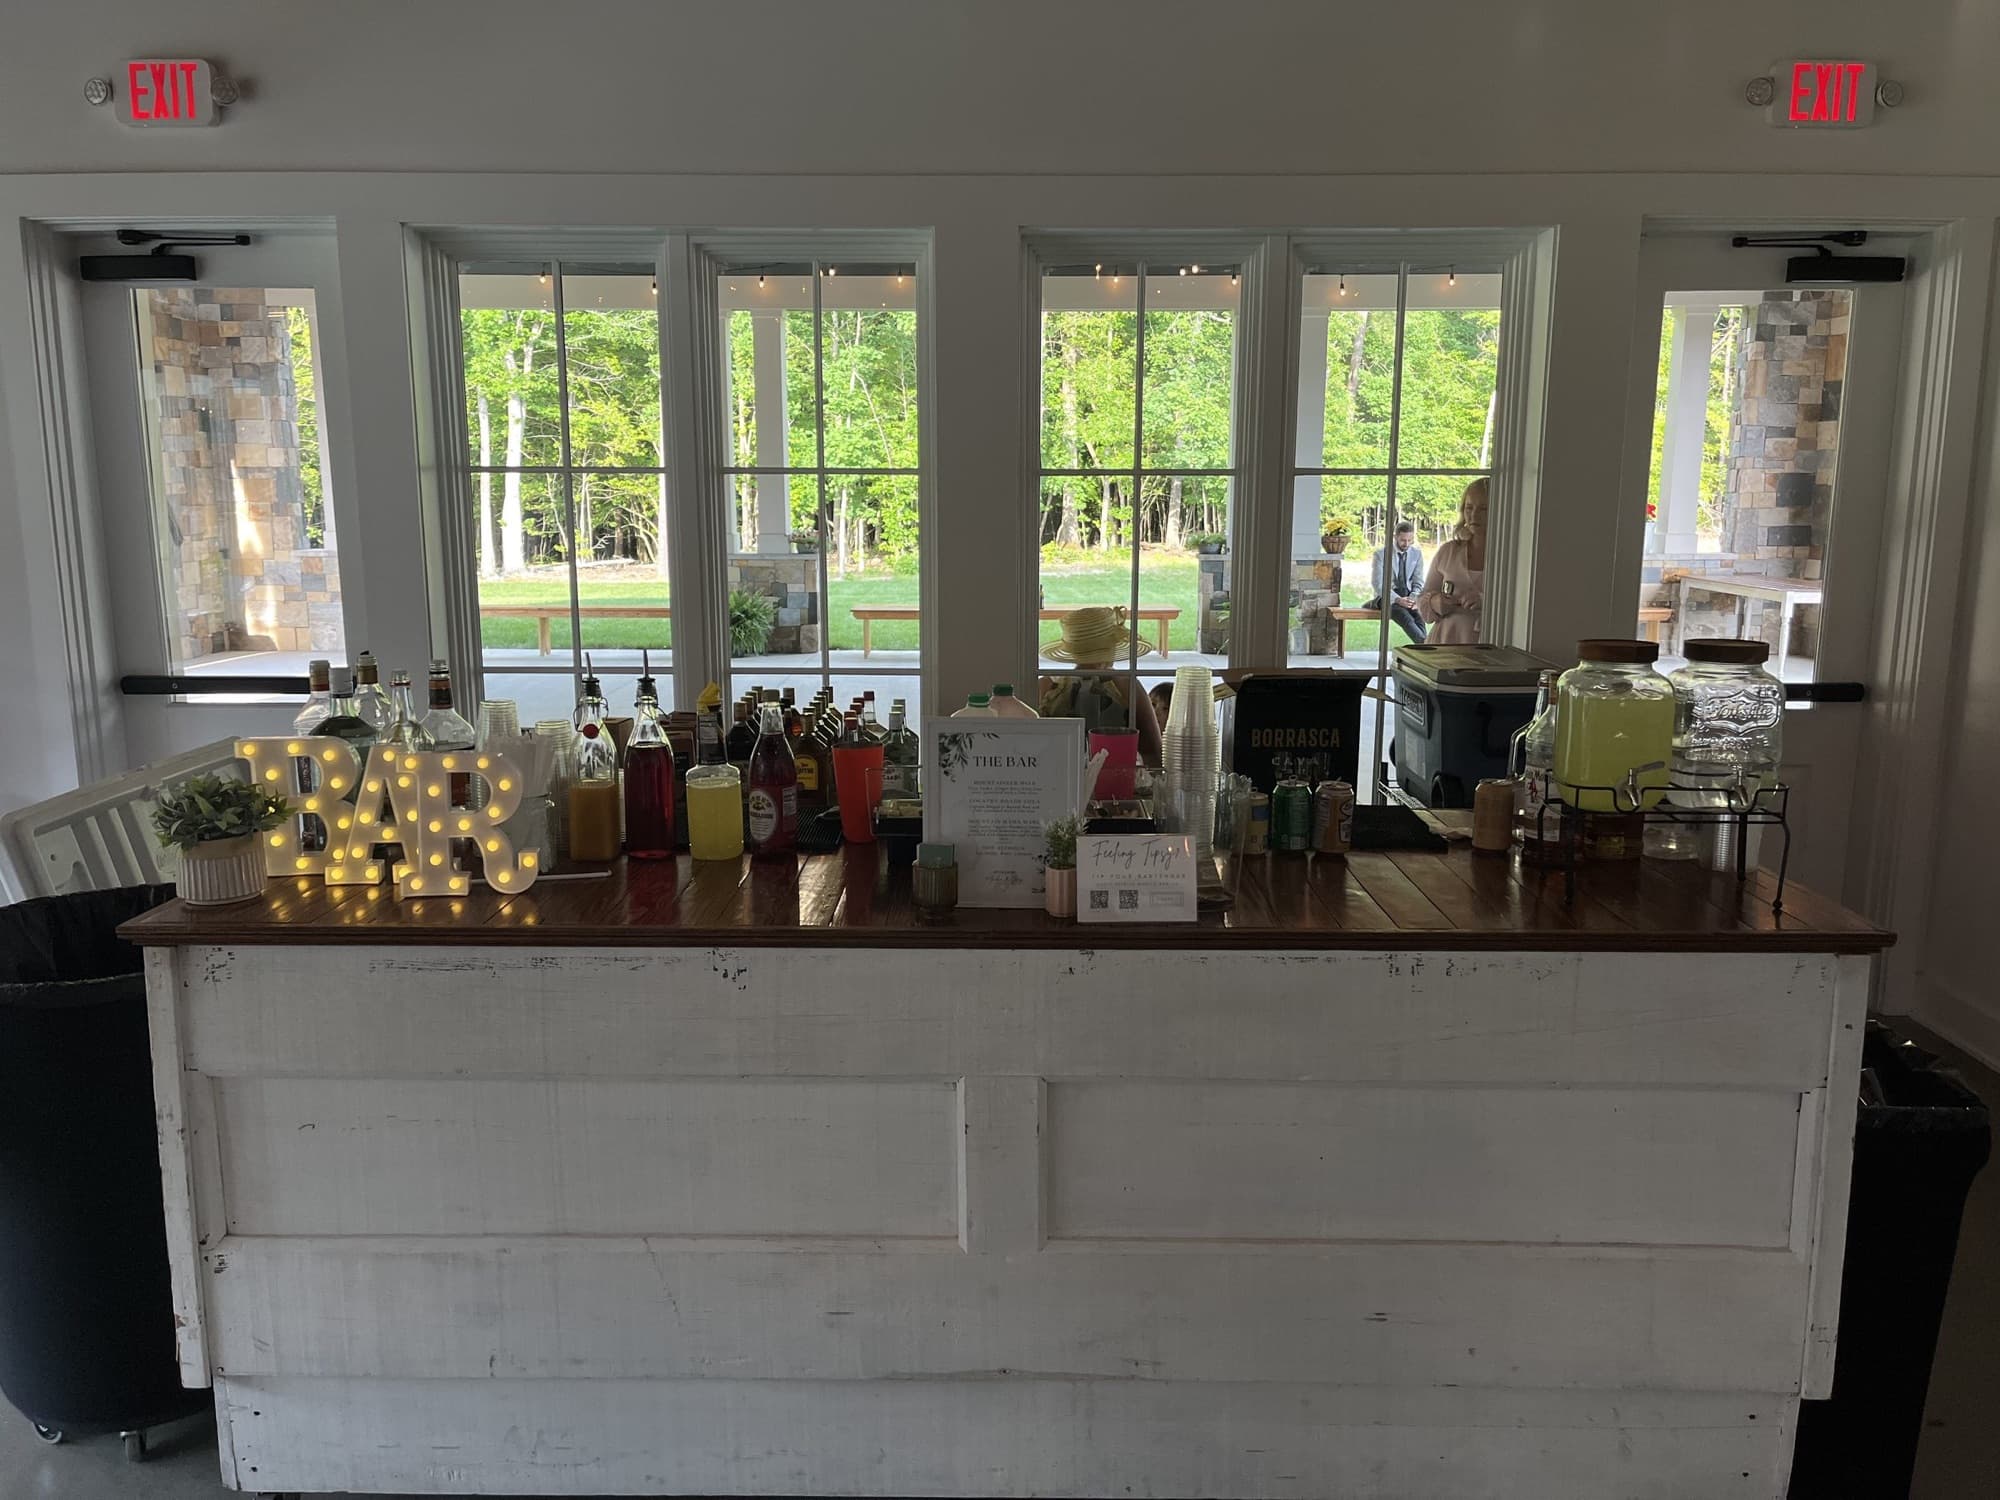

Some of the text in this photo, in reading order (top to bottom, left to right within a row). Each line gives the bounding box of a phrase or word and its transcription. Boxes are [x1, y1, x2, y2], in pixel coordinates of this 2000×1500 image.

[128, 62, 197, 119] EXIT
[1789, 63, 1865, 121] EXIT
[1251, 728, 1340, 748] BORRASCA
[972, 755, 1038, 768] THE BAR
[1091, 840, 1136, 870] Feeling
